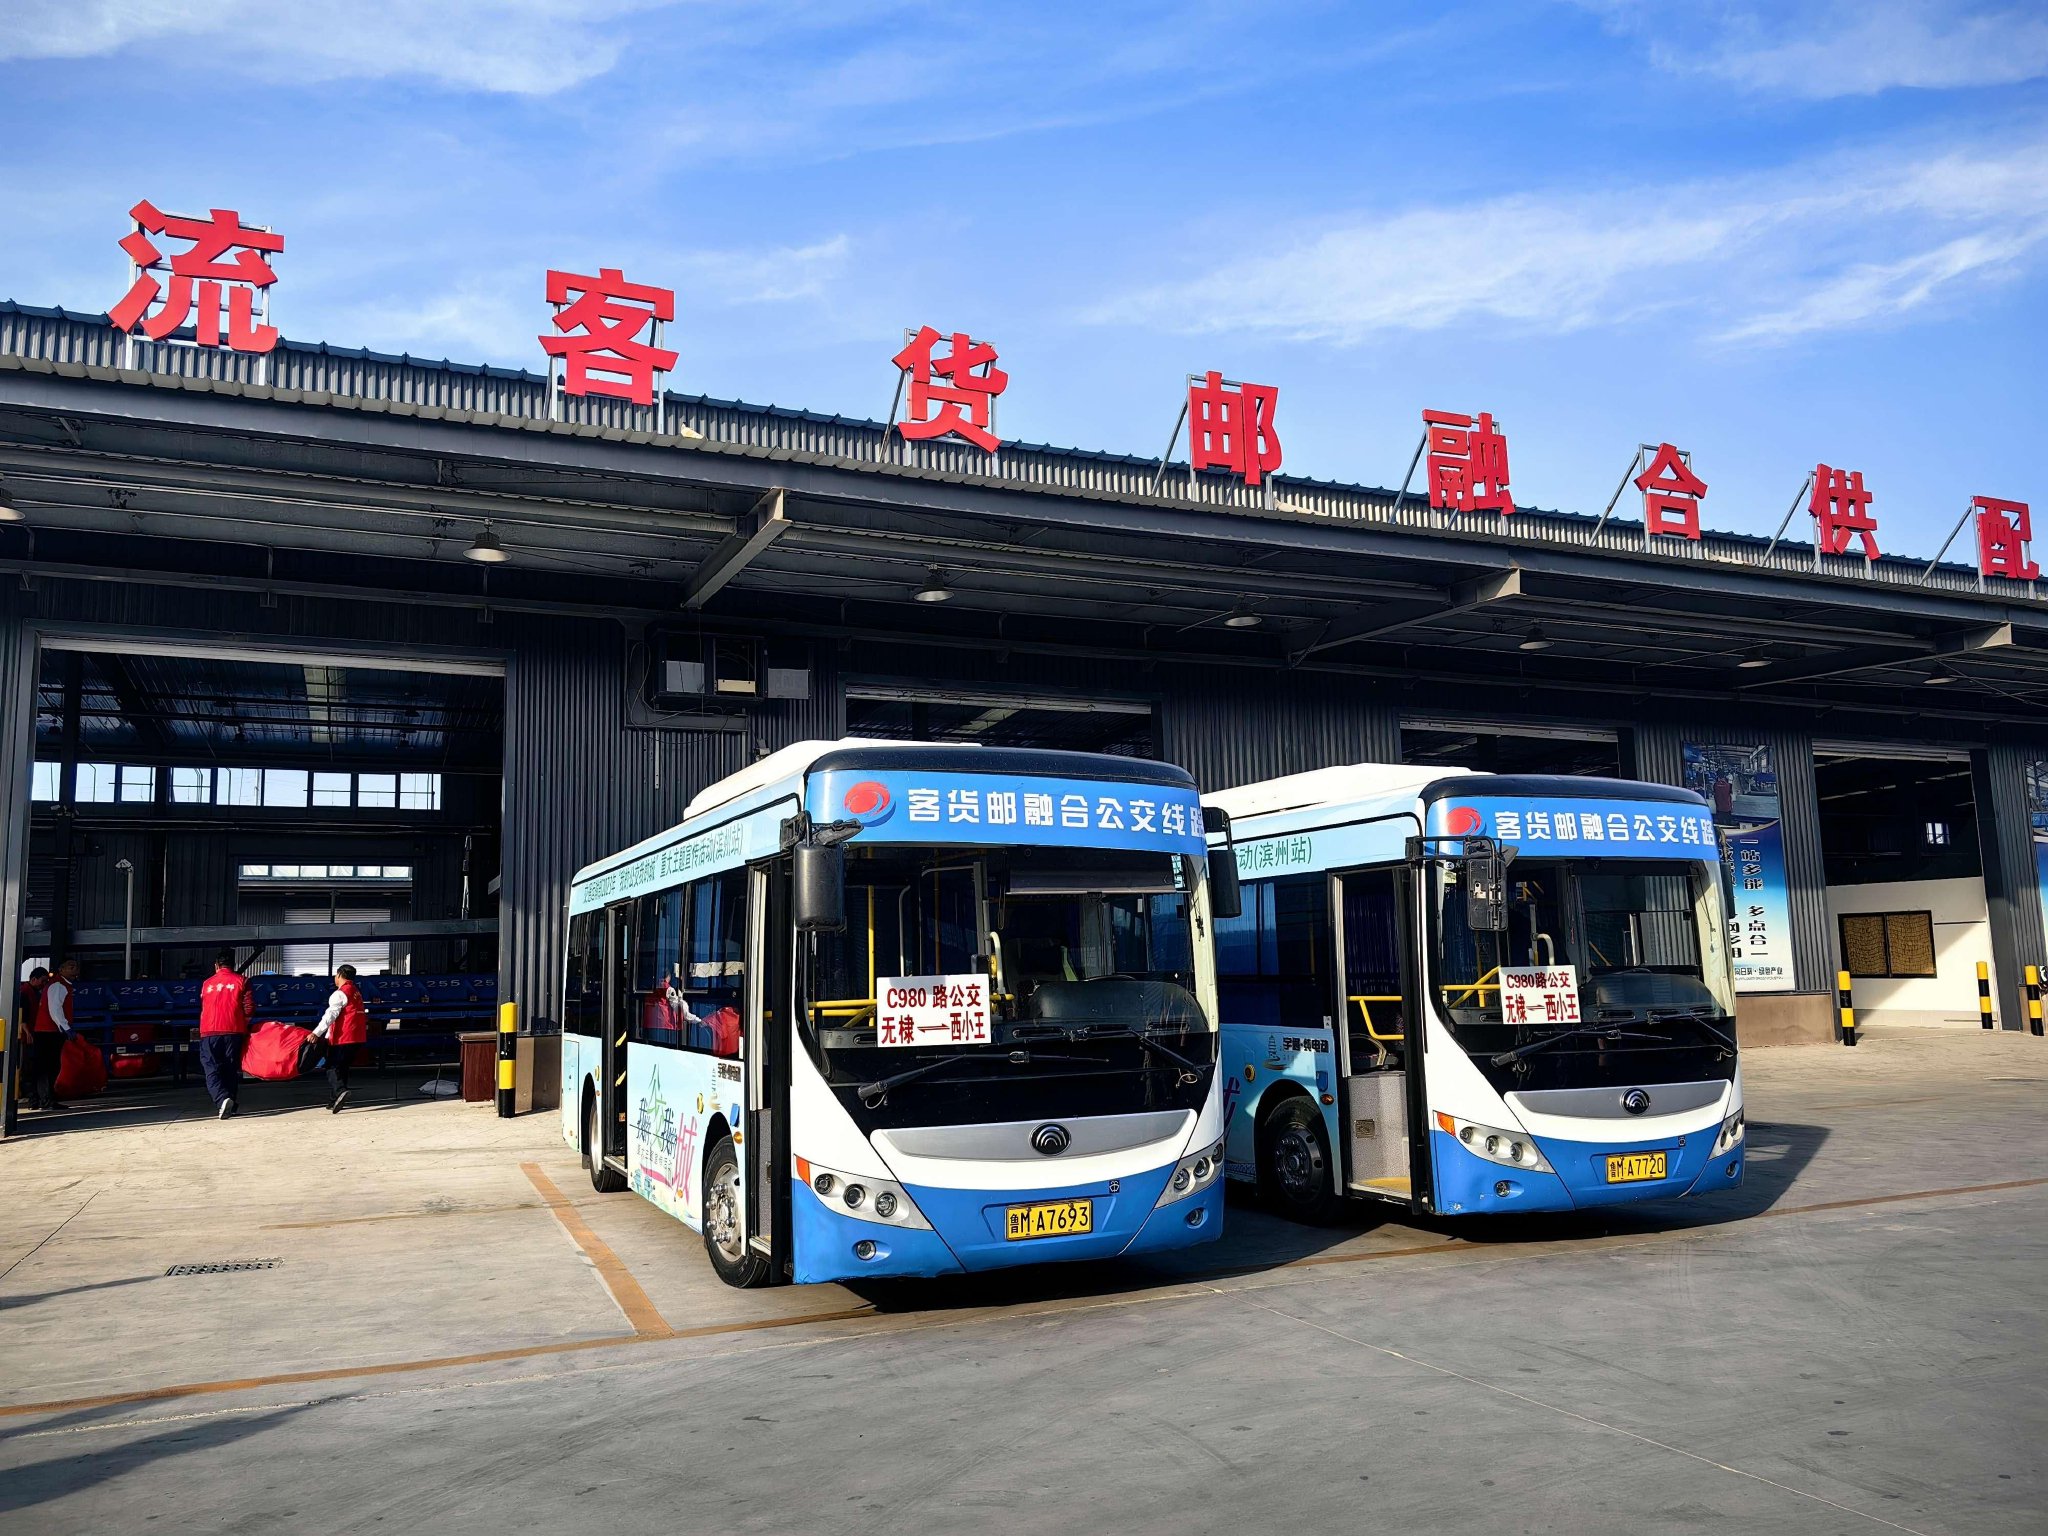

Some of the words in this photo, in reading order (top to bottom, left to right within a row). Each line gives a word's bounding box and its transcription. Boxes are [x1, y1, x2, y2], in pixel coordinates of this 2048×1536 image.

[1495, 811, 1716, 846] 客货邮融合公交线路
[1233, 836, 1312, 871] 动(滨州站)
[120, 985, 159, 996] 243
[277, 982, 316, 992] 249
[379, 980, 414, 990] 253
[427, 978, 461, 988] 255
[887, 987, 927, 1009] C980
[932, 983, 982, 1009] 路公交
[1543, 992, 1579, 1021] 西小王
[881, 1014, 915, 1044] 无棣
[949, 1010, 986, 1041] 西小王
[1010, 1206, 1088, 1234] 鲁M·A7693
